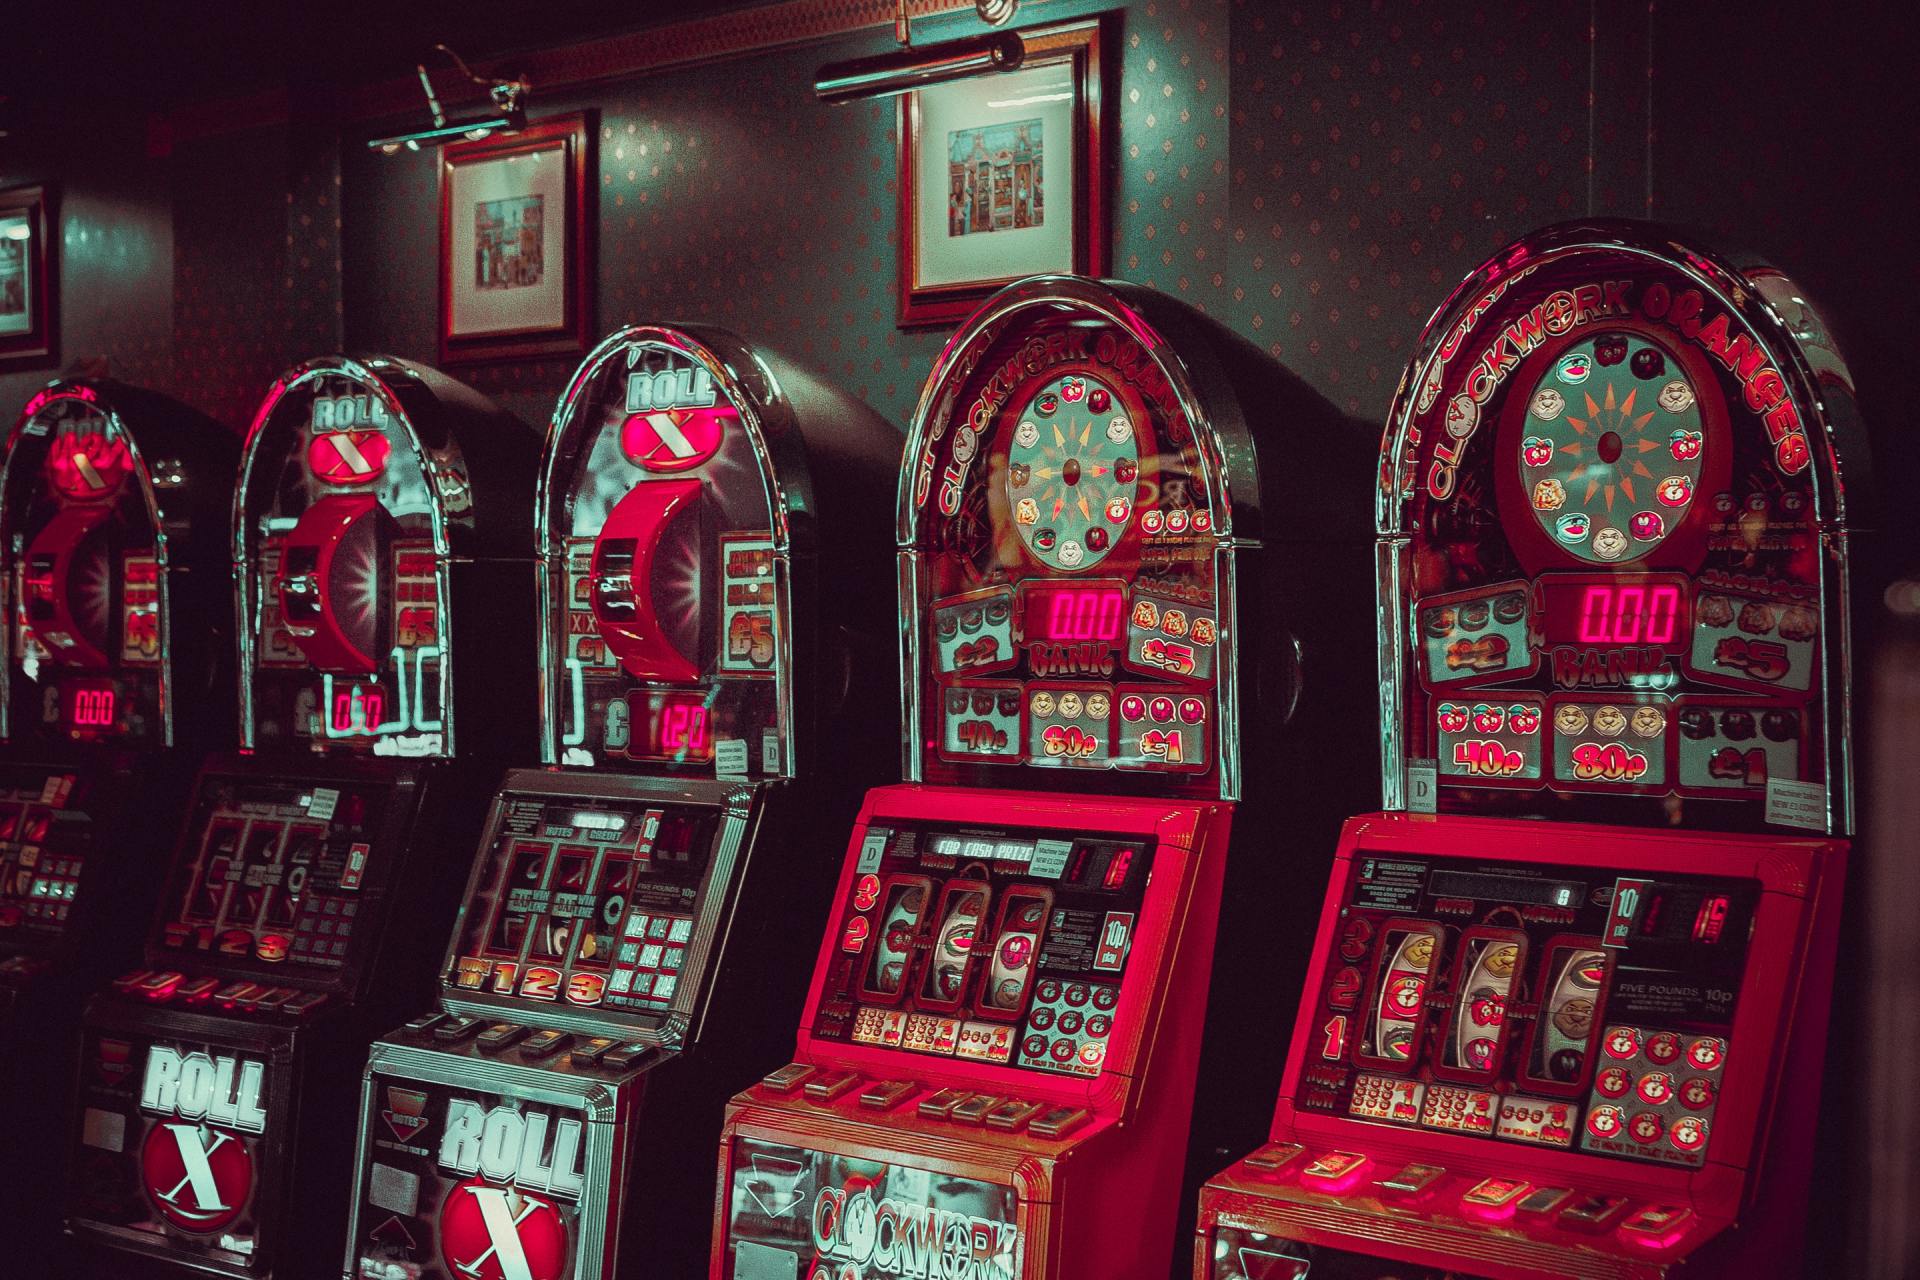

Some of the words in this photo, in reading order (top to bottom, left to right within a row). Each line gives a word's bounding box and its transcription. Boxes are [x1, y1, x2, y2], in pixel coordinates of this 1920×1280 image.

[626, 368, 716, 413] ROLL
[1426, 281, 1634, 500] CLOCKWORK
[1641, 283, 1810, 476] ORANGES
[312, 394, 389, 434] ROLL
[939, 330, 1088, 516] CLOCKWORK
[640, 412, 705, 460] X
[729, 610, 775, 669] £5
[953, 636, 999, 668] £2
[1029, 641, 1114, 678] BANK
[1142, 640, 1195, 675] £5
[1447, 632, 1509, 672] £2
[1714, 635, 1789, 682] £5
[1552, 645, 1674, 691] BANK
[958, 720, 1008, 752] 40p
[1041, 725, 1098, 758] 80p
[1140, 730, 1184, 764] £1
[1453, 740, 1524, 777] 40p
[1572, 742, 1648, 781] 80p
[1709, 747, 1767, 785] £1
[1416, 780, 1428, 797] D
[938, 839, 961, 855] FOR
[964, 842, 994, 858] CASH
[854, 874, 880, 911] 3
[843, 915, 869, 953] 2
[493, 962, 519, 995] 1
[519, 966, 562, 1000] 2
[565, 972, 606, 1006] 3
[1648, 985, 1699, 997] POUNDS
[1705, 988, 1733, 1004] 10p
[1323, 1016, 1347, 1060] 1
[140, 1043, 266, 1134] ROLL
[154, 1122, 234, 1213] X
[437, 1097, 584, 1200] ROLL
[454, 1185, 549, 1280] X
[812, 1185, 1017, 1280] CLOCKWORK
